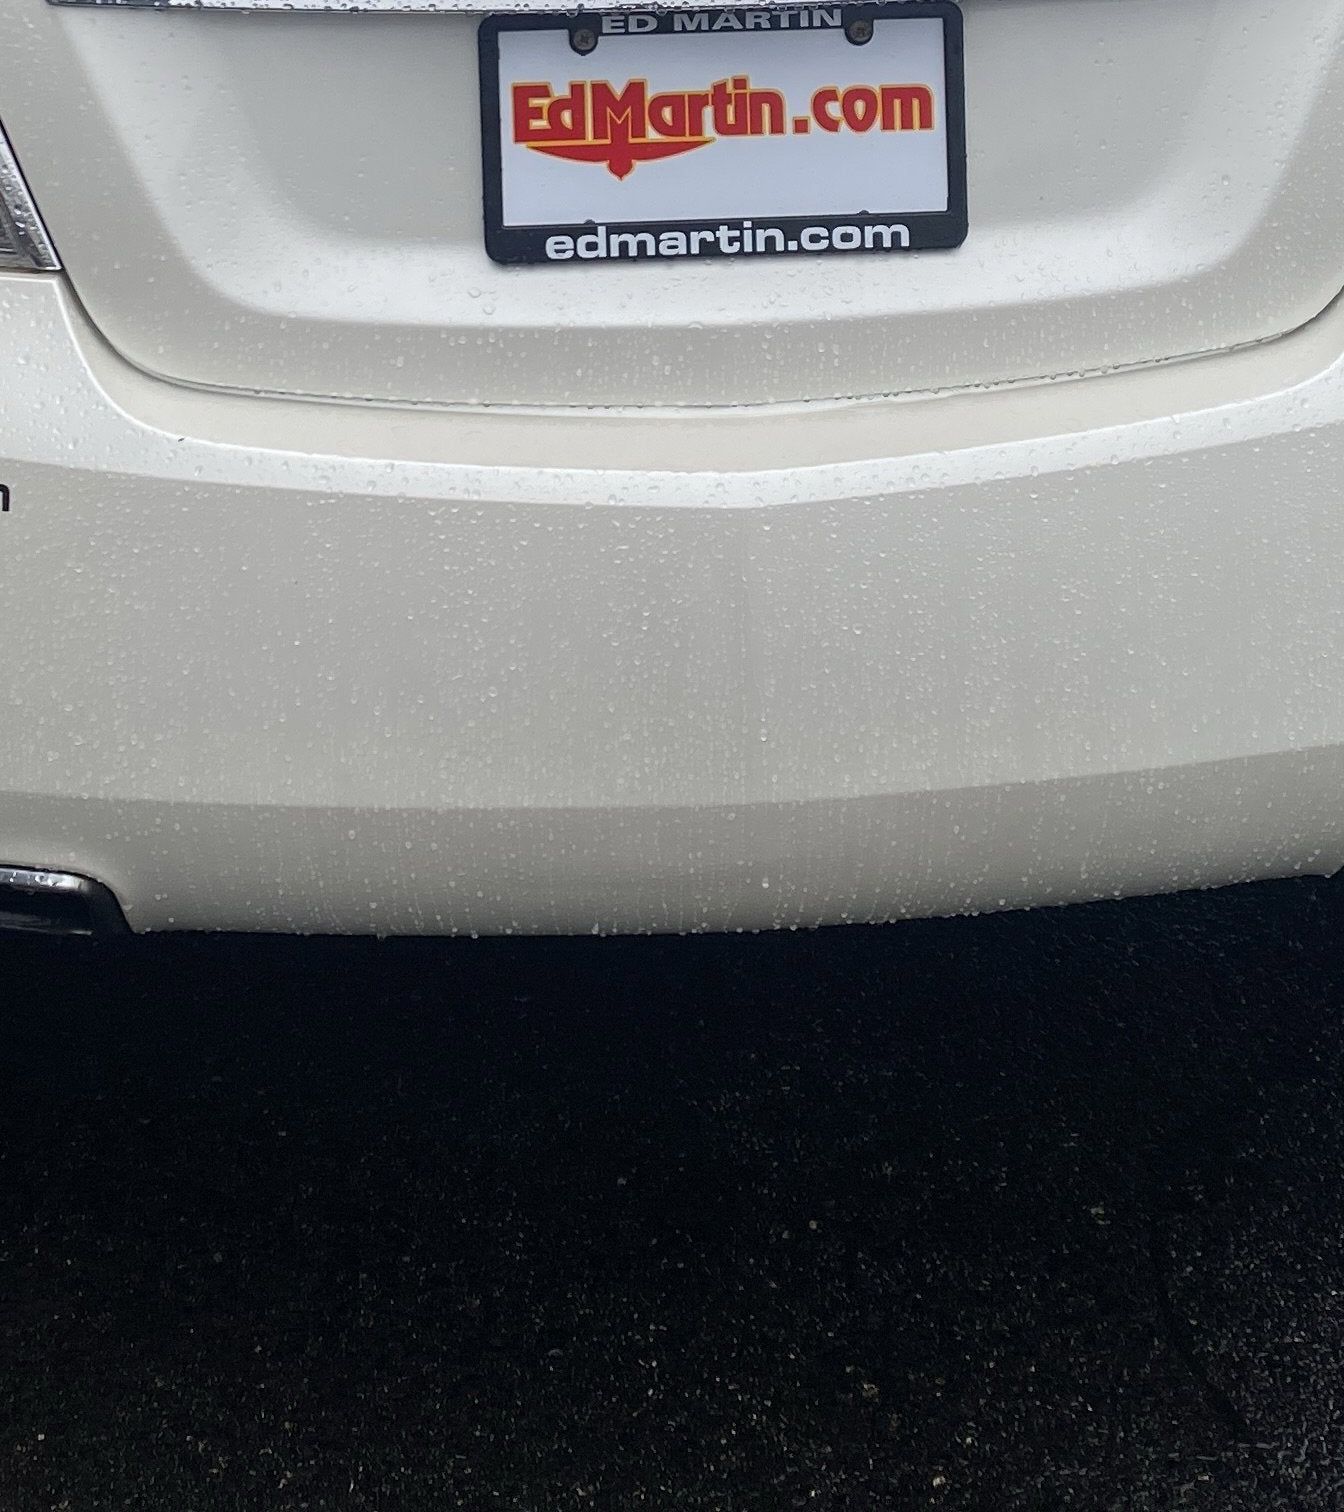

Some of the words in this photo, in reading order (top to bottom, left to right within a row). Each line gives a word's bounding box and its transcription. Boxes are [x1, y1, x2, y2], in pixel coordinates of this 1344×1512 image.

[601, 13, 659, 34] ED
[672, 8, 843, 32] MARTIN
[510, 75, 936, 145] EdMartin.com
[544, 219, 911, 261] edmartin.com
